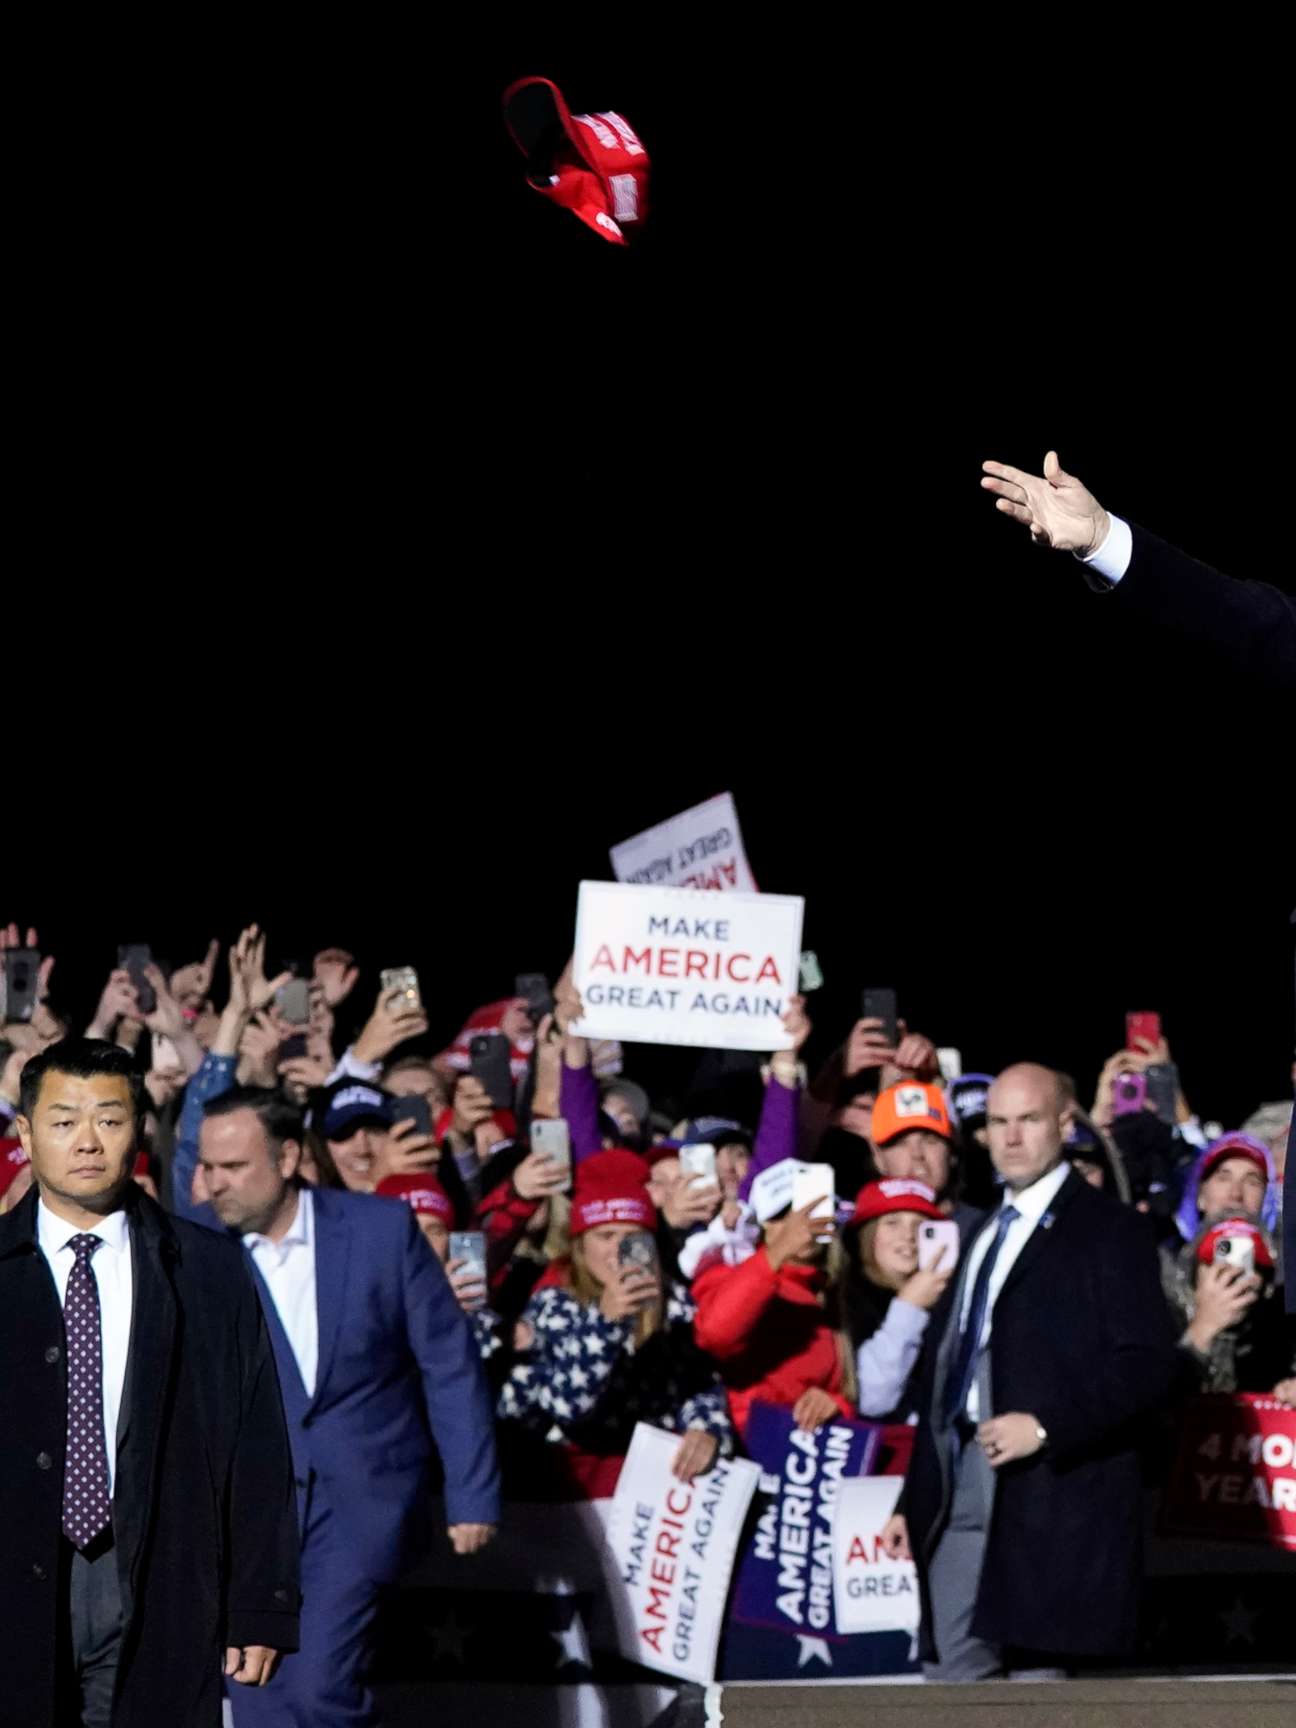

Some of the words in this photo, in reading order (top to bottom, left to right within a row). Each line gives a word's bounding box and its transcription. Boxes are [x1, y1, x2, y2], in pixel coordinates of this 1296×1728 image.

[647, 915, 731, 942] MAKE
[589, 943, 783, 986] AMERICA
[585, 984, 681, 1011] GREAT
[690, 993, 784, 1017] AGAIN
[1196, 1431, 1224, 1462] 4
[753, 1472, 780, 1560] MAE
[624, 1500, 654, 1586] MAKE
[672, 1570, 701, 1662] GREAT
[691, 1467, 731, 1559] AGAIN
[807, 1531, 833, 1630] GREAT
[846, 1574, 913, 1600] GREA
